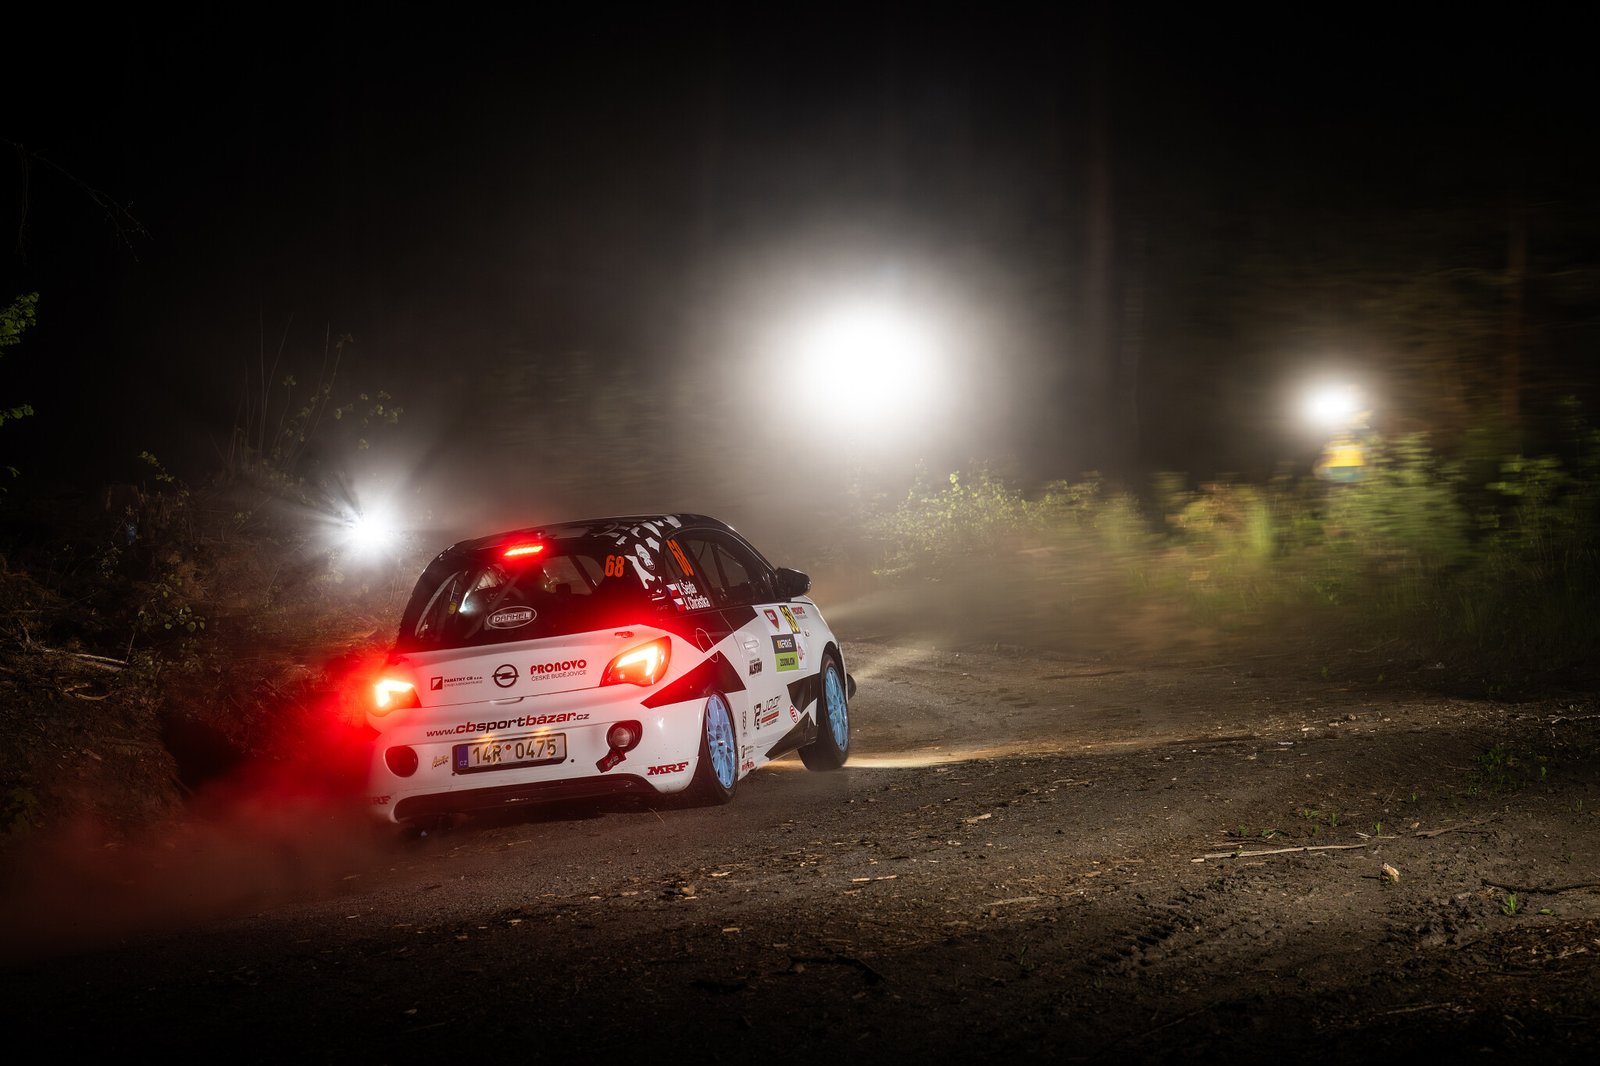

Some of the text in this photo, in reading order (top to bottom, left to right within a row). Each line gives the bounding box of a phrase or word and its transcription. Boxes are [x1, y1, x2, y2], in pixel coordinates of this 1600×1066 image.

[604, 554, 625, 577] 68
[530, 659, 587, 675] PRONOVO
[515, 738, 557, 760] 0475
[647, 761, 689, 776] MRF
